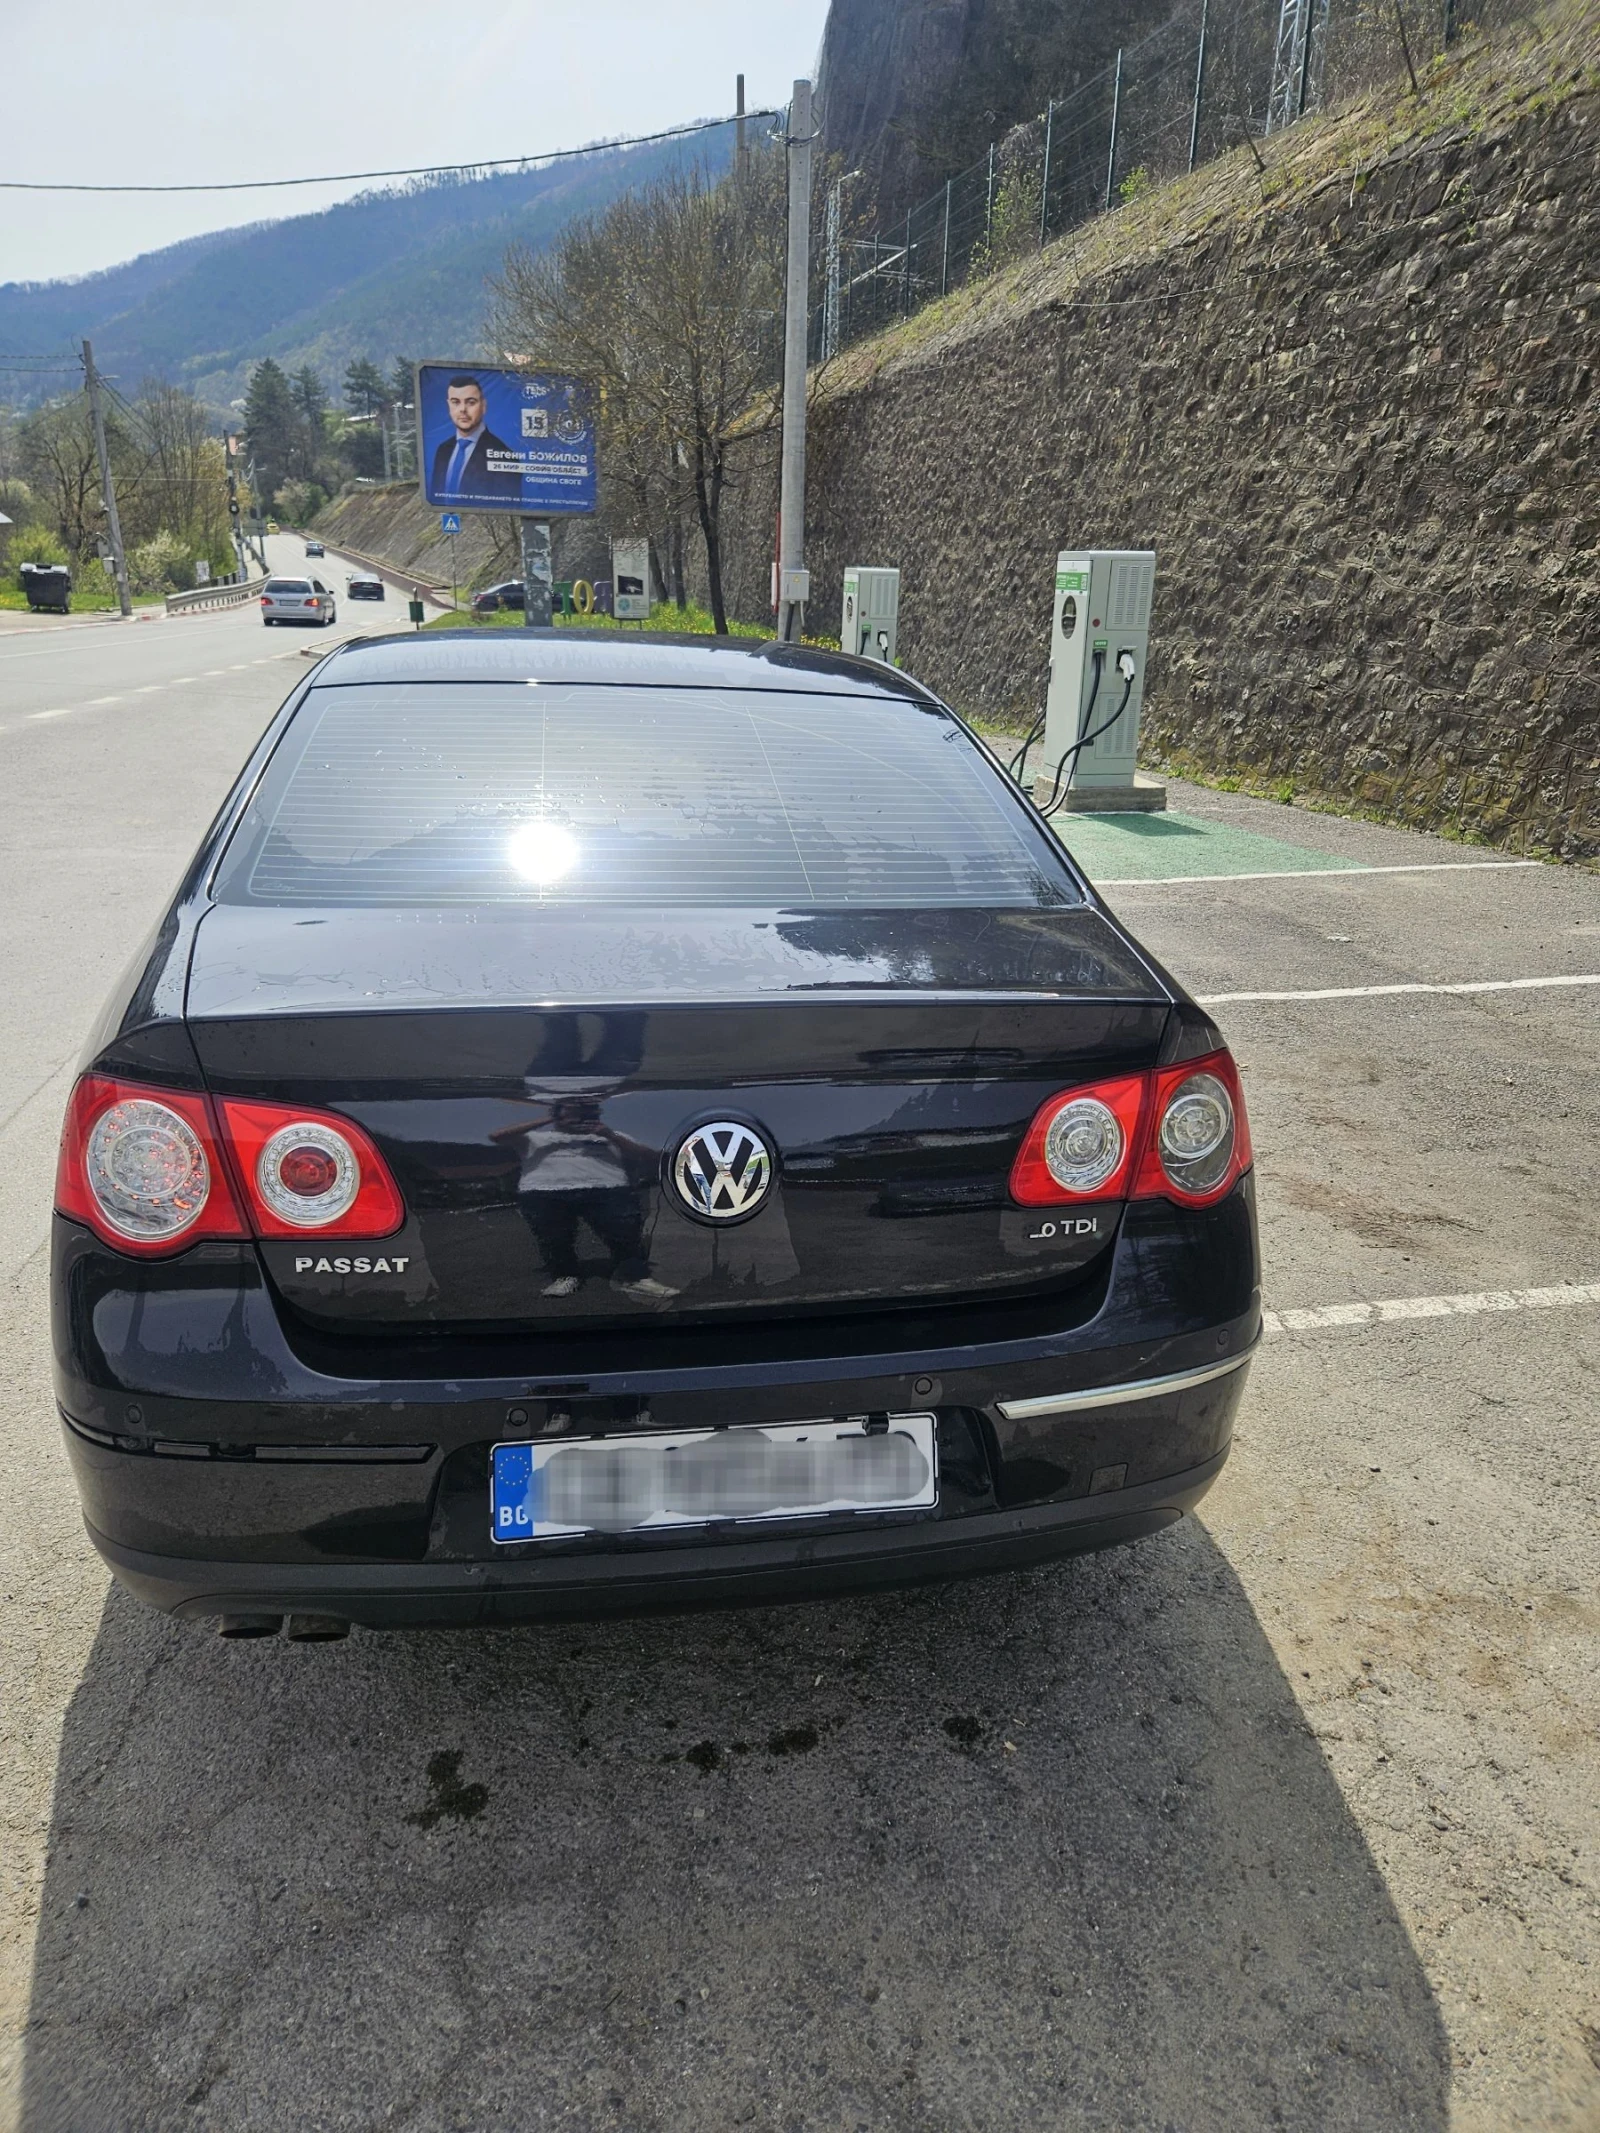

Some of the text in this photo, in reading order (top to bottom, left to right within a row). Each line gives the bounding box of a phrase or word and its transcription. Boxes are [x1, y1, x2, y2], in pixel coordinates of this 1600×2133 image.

[486, 448, 588, 464] Евгени БОЖИЛОВ
[525, 476, 583, 486] ОБЩИНА СВОГЕ
[1060, 1217, 1097, 1235] TDI
[295, 1257, 409, 1274] PASSAT
